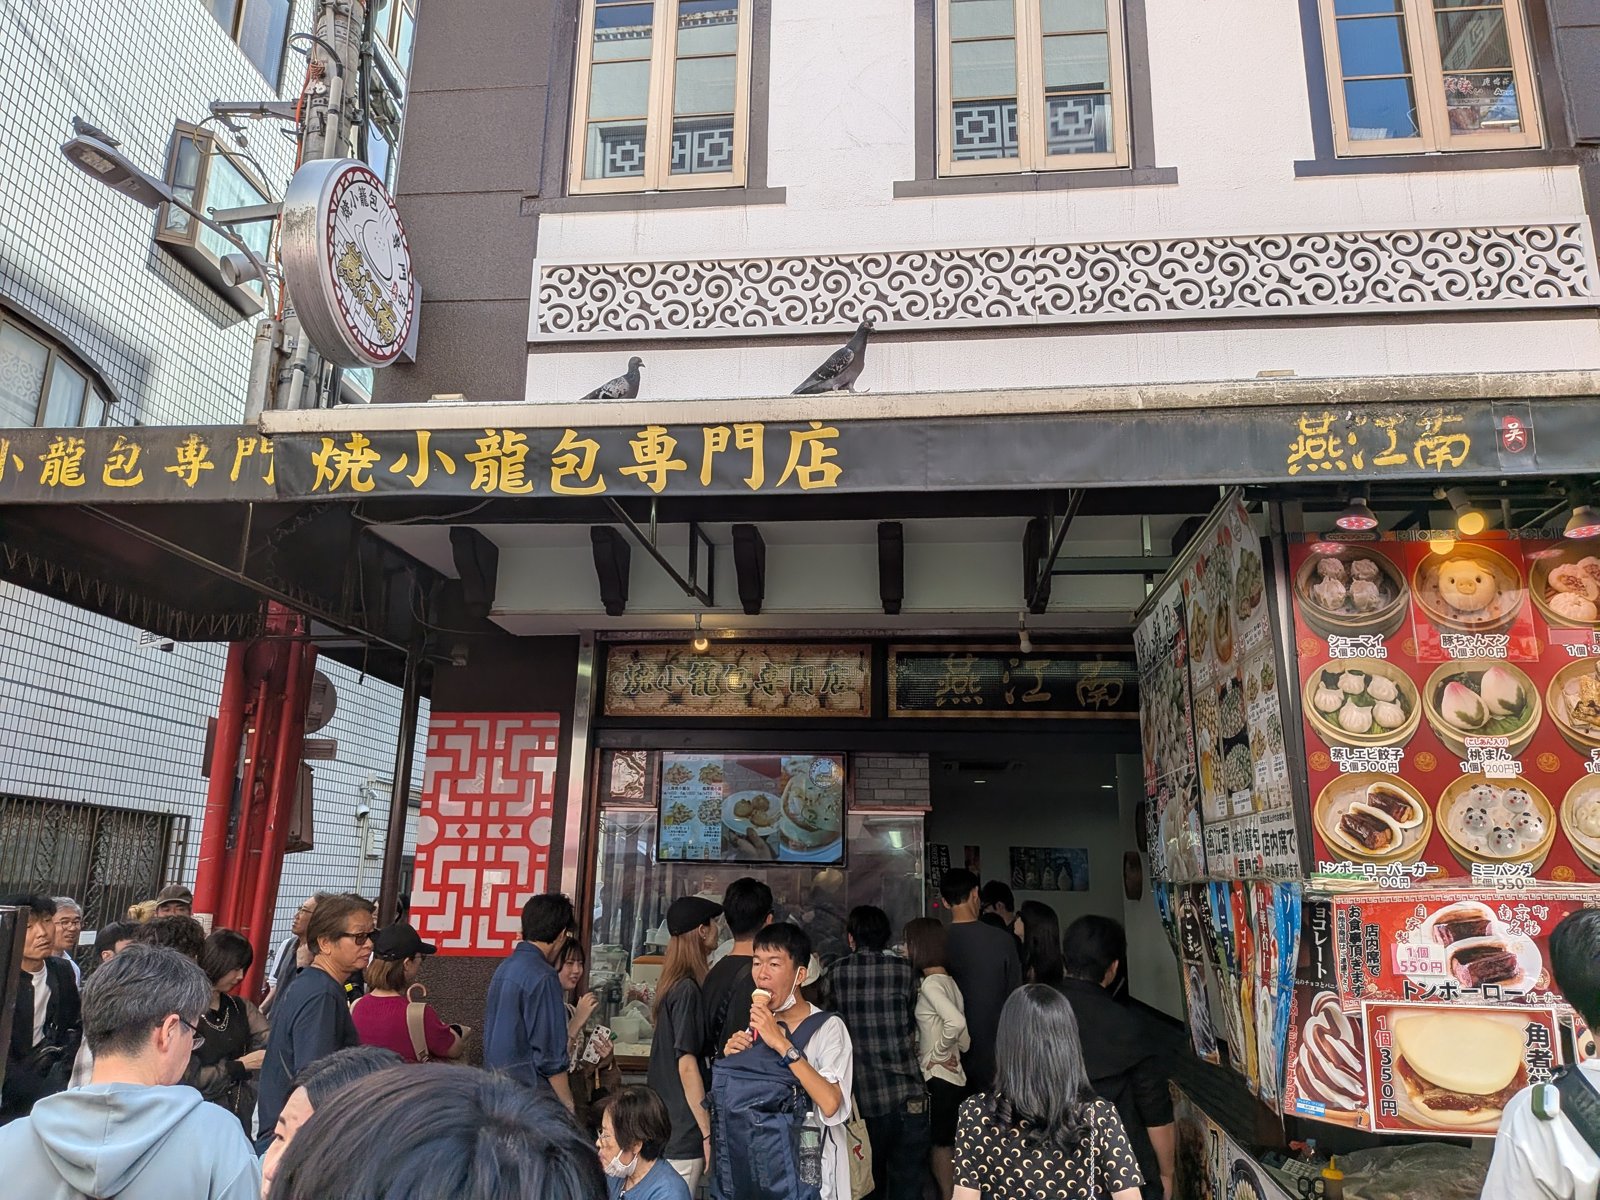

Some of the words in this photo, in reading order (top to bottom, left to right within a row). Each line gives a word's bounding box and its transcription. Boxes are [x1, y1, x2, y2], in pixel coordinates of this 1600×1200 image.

[1287, 410, 1471, 475] 燕江南
[311, 423, 842, 494] 焼小龍包専門店
[1328, 634, 1384, 647] シューマイ
[1440, 633, 1509, 647] 豚ちゃんマン
[1329, 647, 1387, 658] 5個500円
[1449, 646, 1507, 658] 1個300円
[935, 653, 1124, 708] 燕江南
[1331, 748, 1404, 761] 蒸しエビ餃子
[1468, 748, 1511, 761] 桃まん
[1340, 761, 1399, 773] 5個500円
[1319, 862, 1438, 875] トンポーローバーガー
[1472, 862, 1531, 875] ミニパンダ
[1496, 878, 1524, 890] 550
[1498, 904, 1549, 921] 南京町
[1507, 920, 1541, 936] 名物
[1312, 902, 1328, 979] ョコレート
[1365, 925, 1381, 976] 店内席で
[1406, 947, 1429, 959] 1個
[1400, 961, 1443, 973] 550円
[1403, 980, 1525, 1001] トンポーロー
